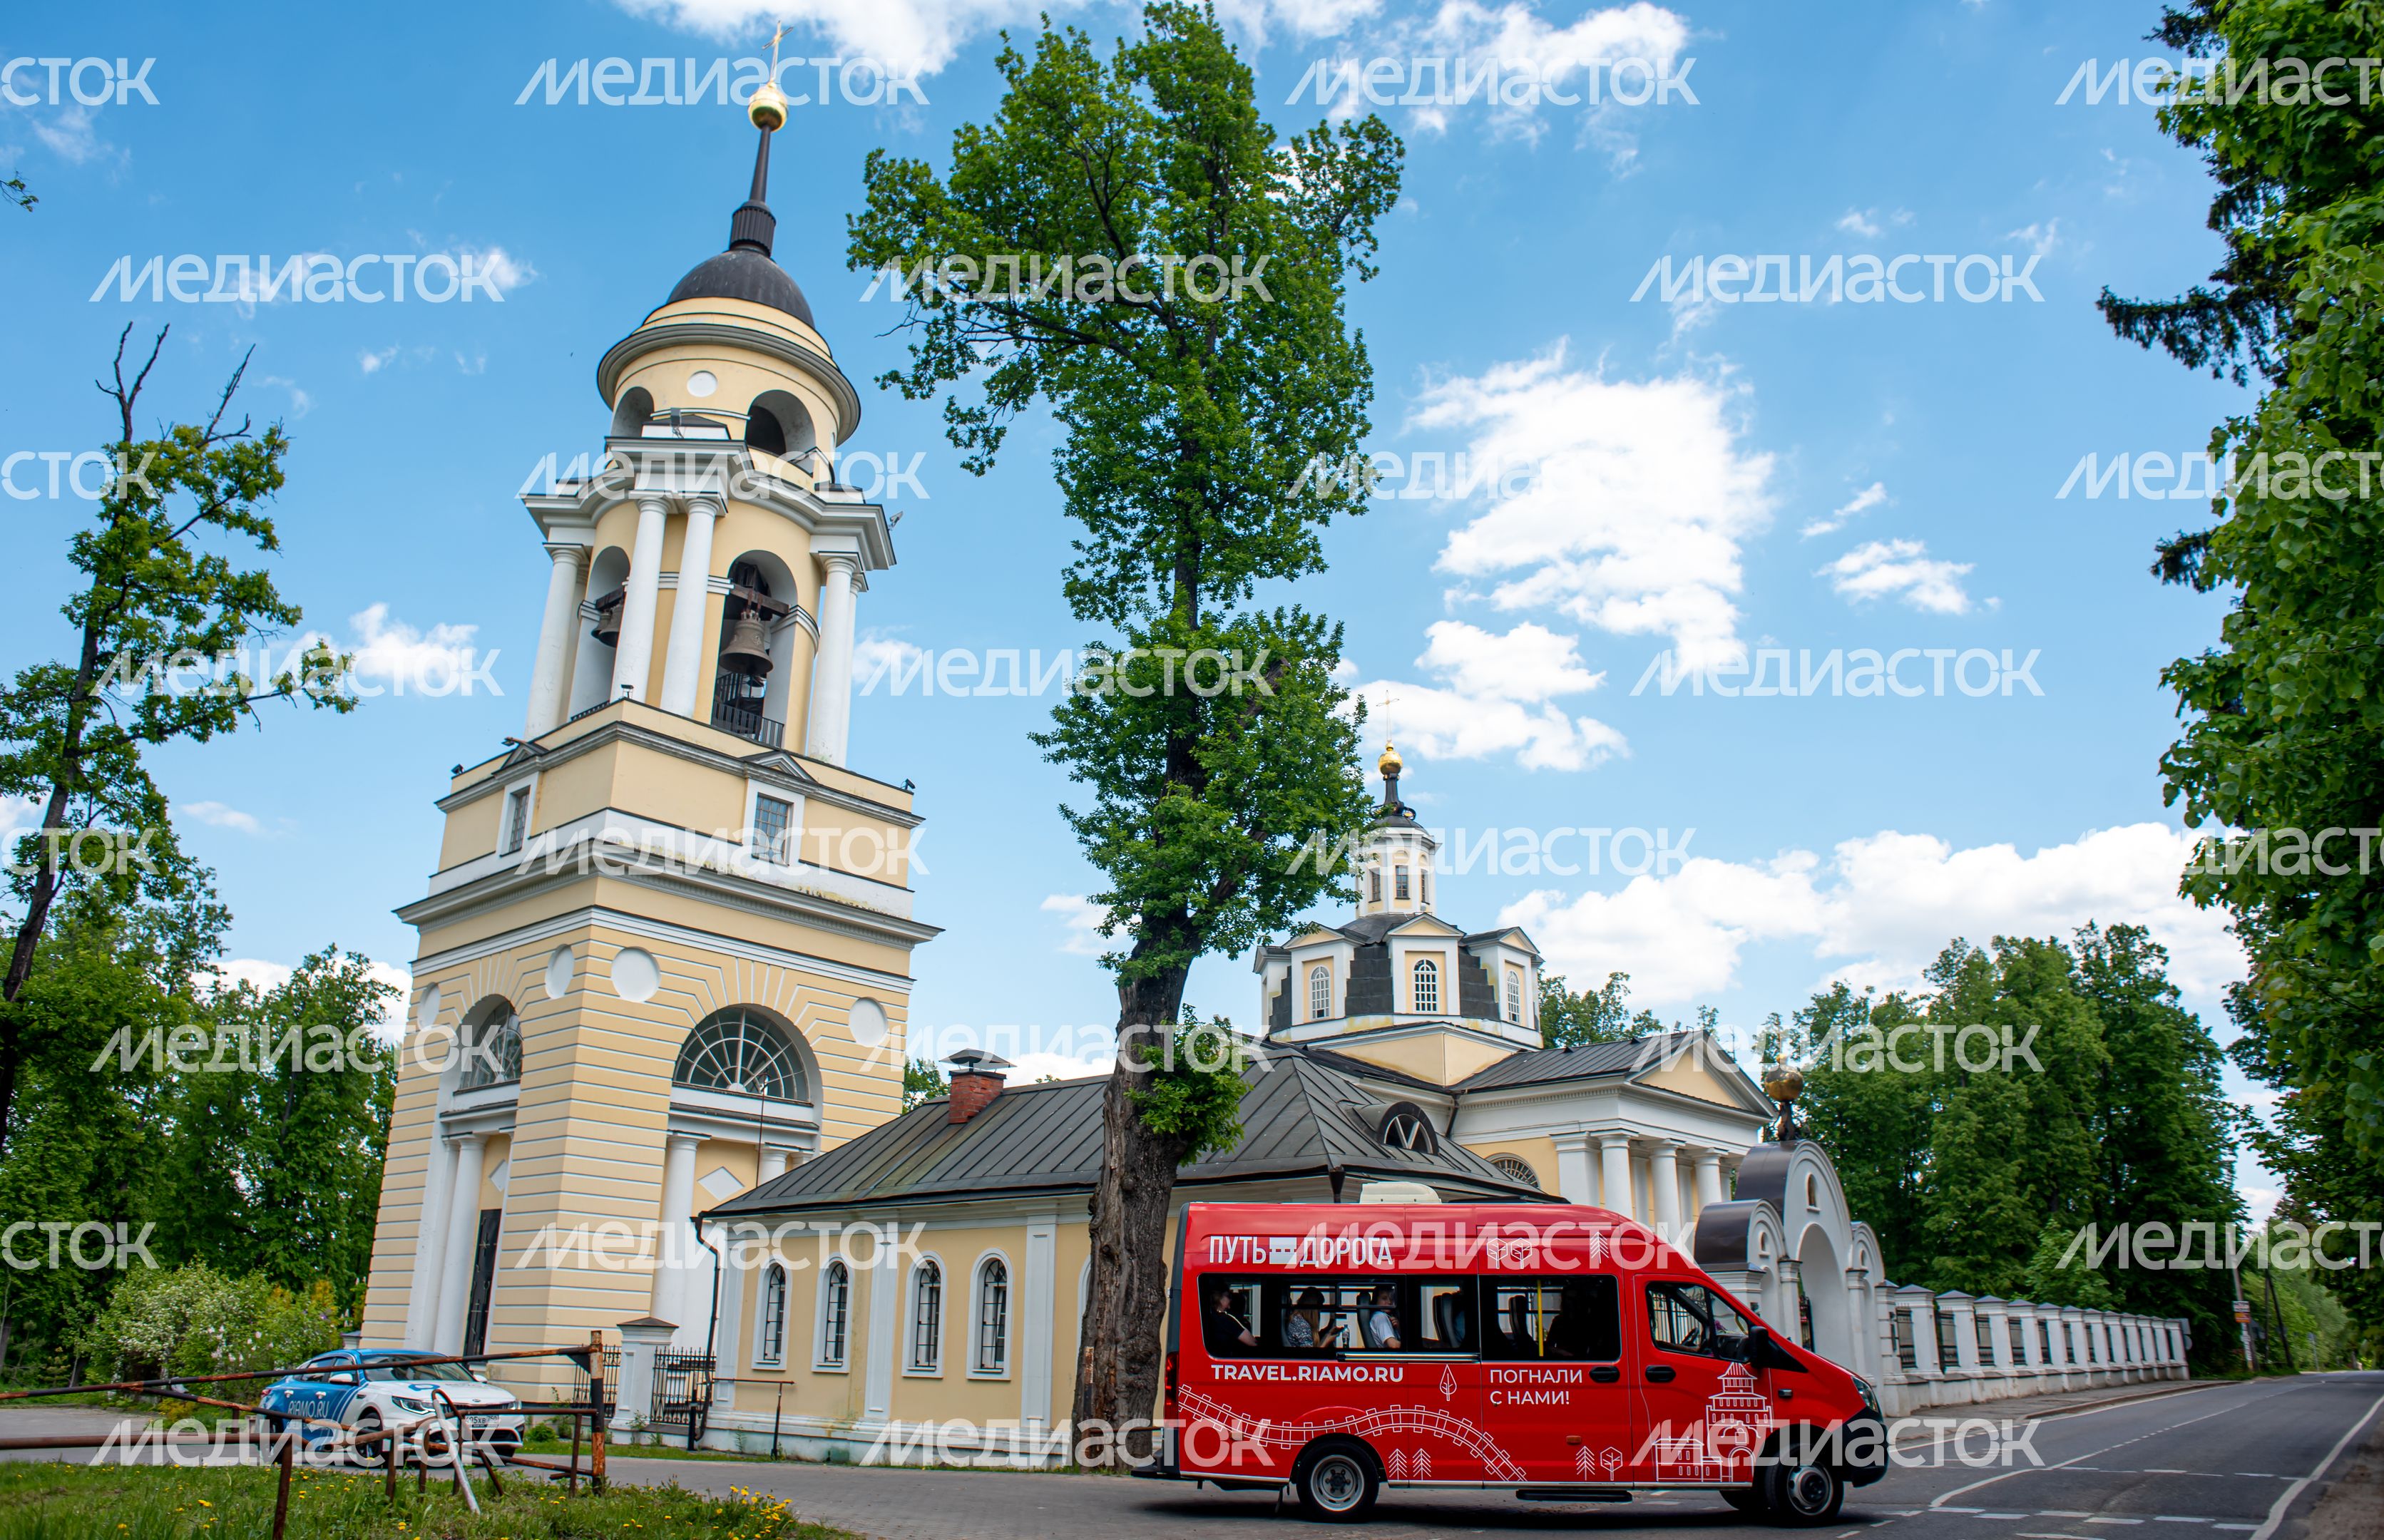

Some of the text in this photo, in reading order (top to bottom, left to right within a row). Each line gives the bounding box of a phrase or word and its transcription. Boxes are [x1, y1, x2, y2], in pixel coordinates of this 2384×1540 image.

[1209, 1236, 1393, 1267] ПУТЬ ДОРОГА
[1211, 1365, 1403, 1382] TRAVEL.RIAMO.RU
[1490, 1369, 1582, 1384] ПОГНАЛИ
[1490, 1390, 1570, 1405] С НАМИ!
